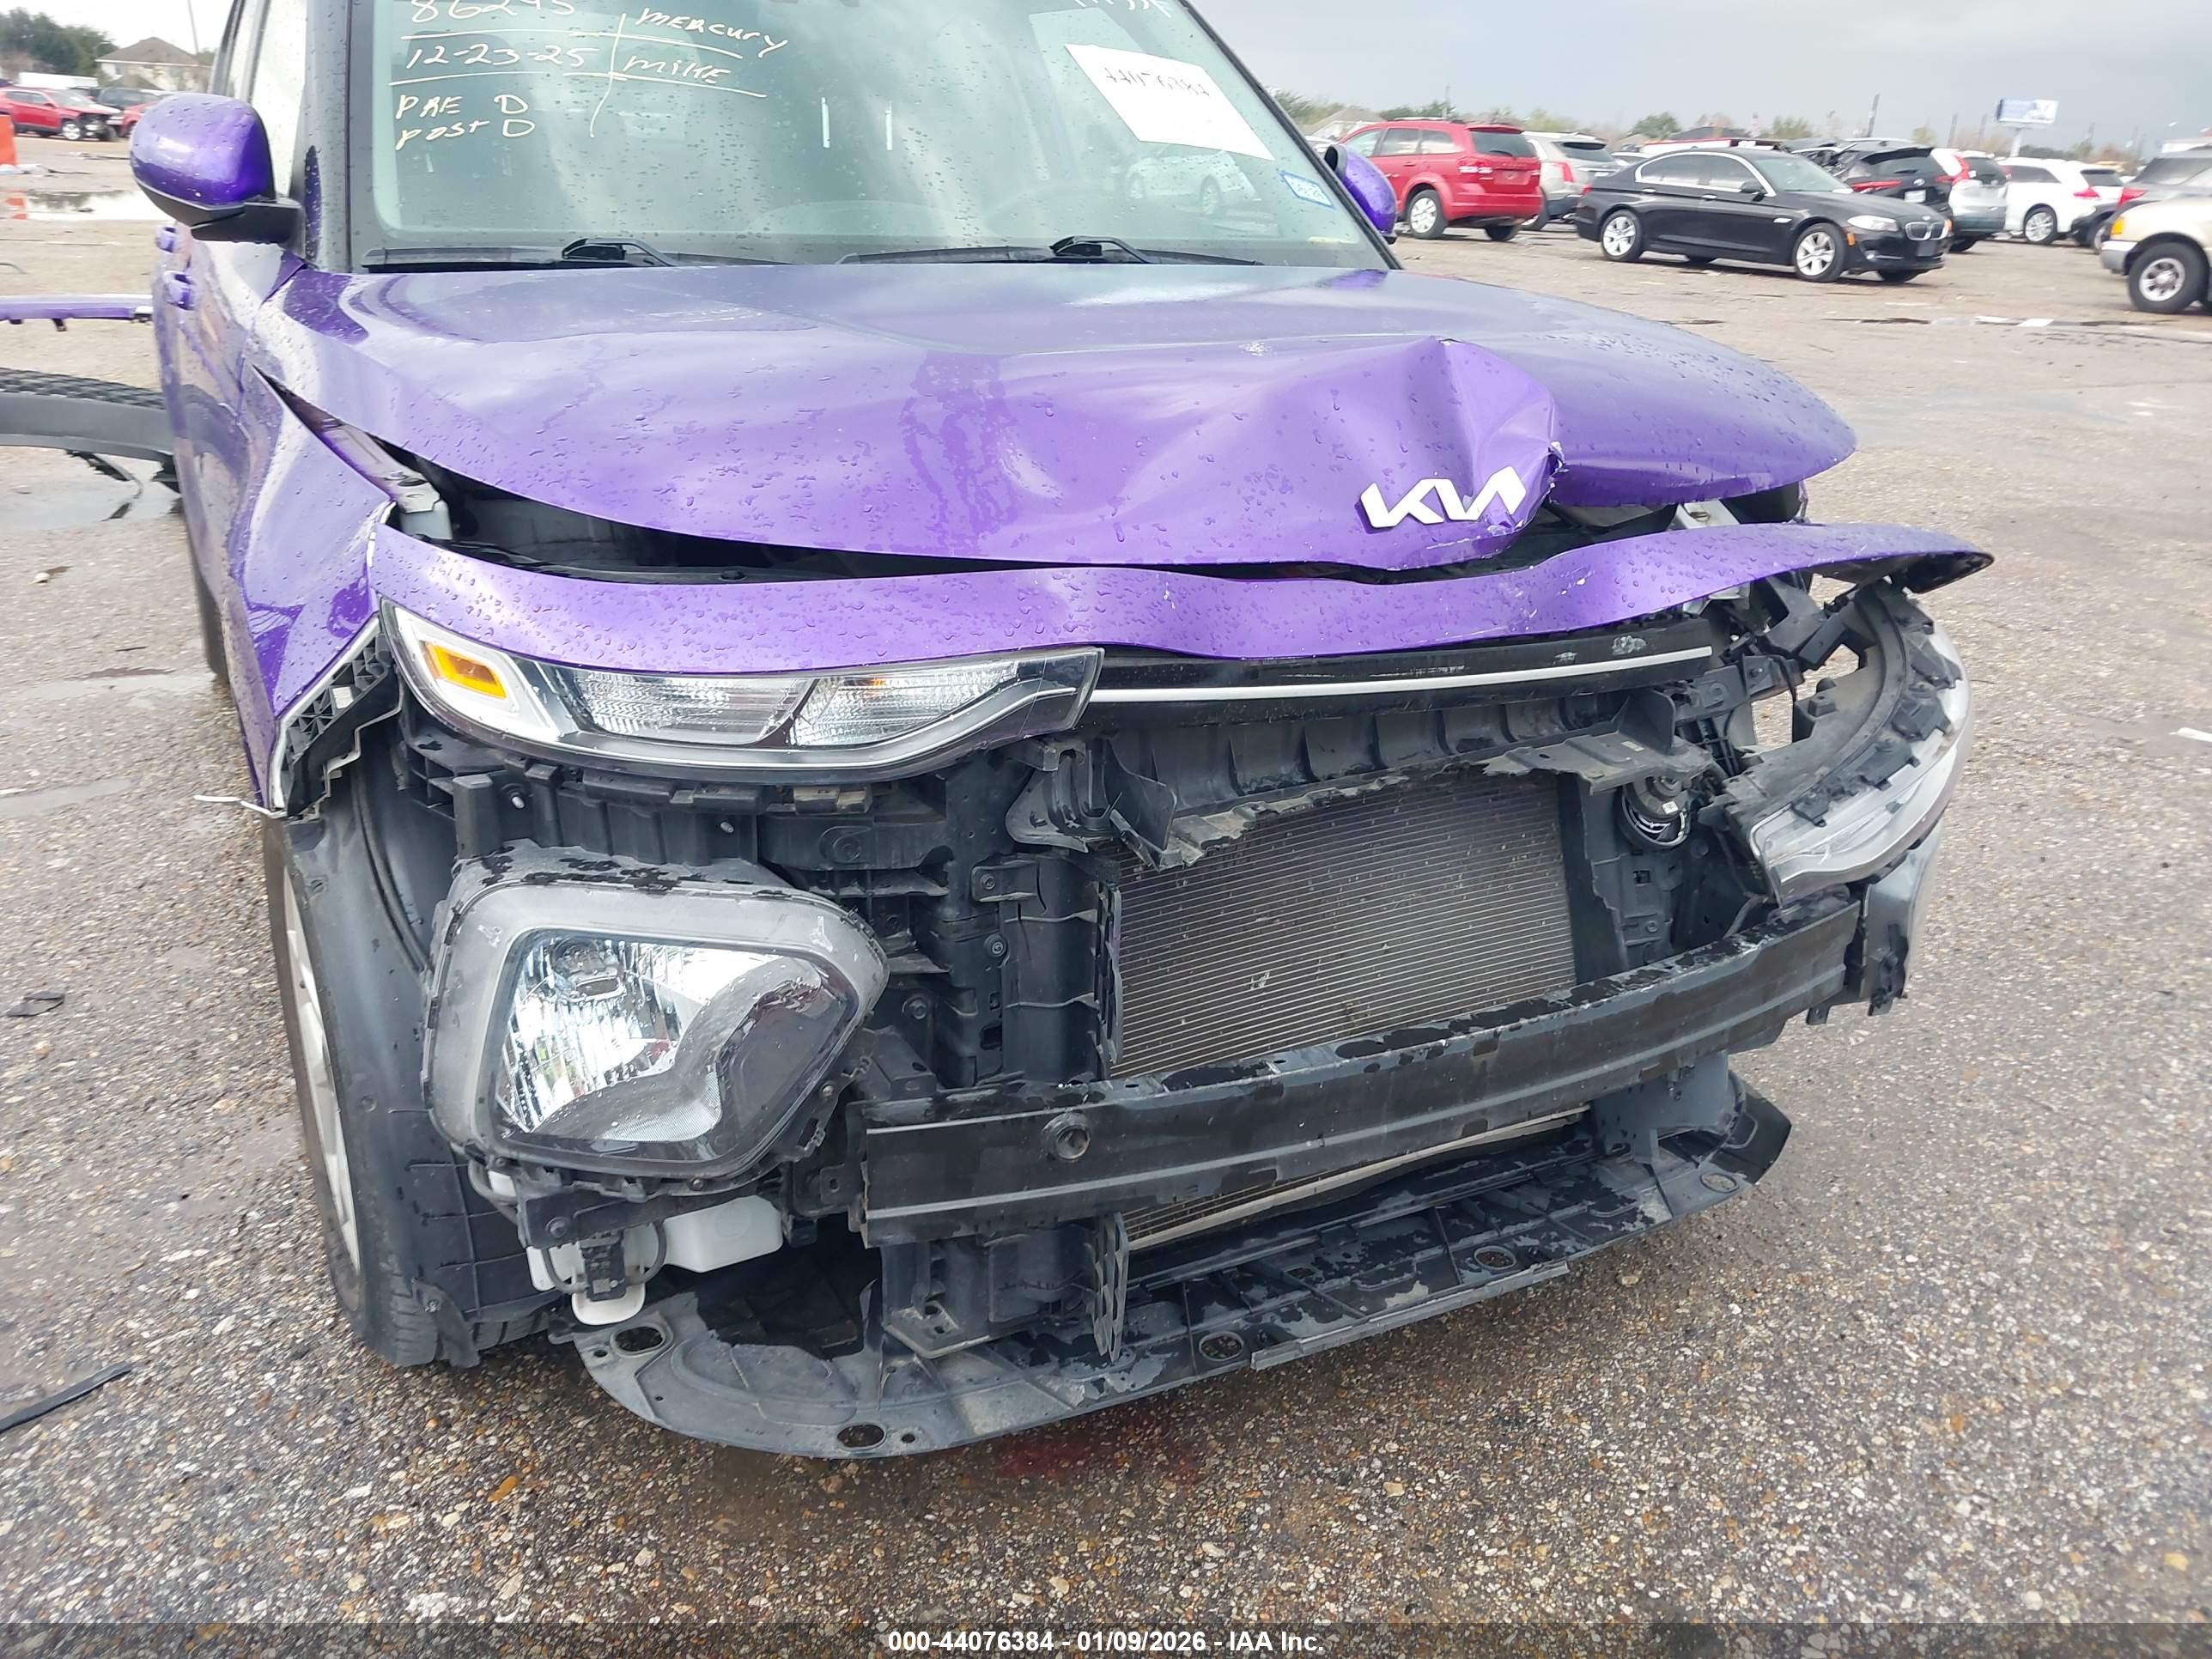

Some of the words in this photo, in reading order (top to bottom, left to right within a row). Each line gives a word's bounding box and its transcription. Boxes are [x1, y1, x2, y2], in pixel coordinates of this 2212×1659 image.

[406, 44, 599, 69] 12-23-25
[494, 94, 529, 115] D
[502, 118, 536, 137] D
[1360, 466, 1526, 528] KIA
